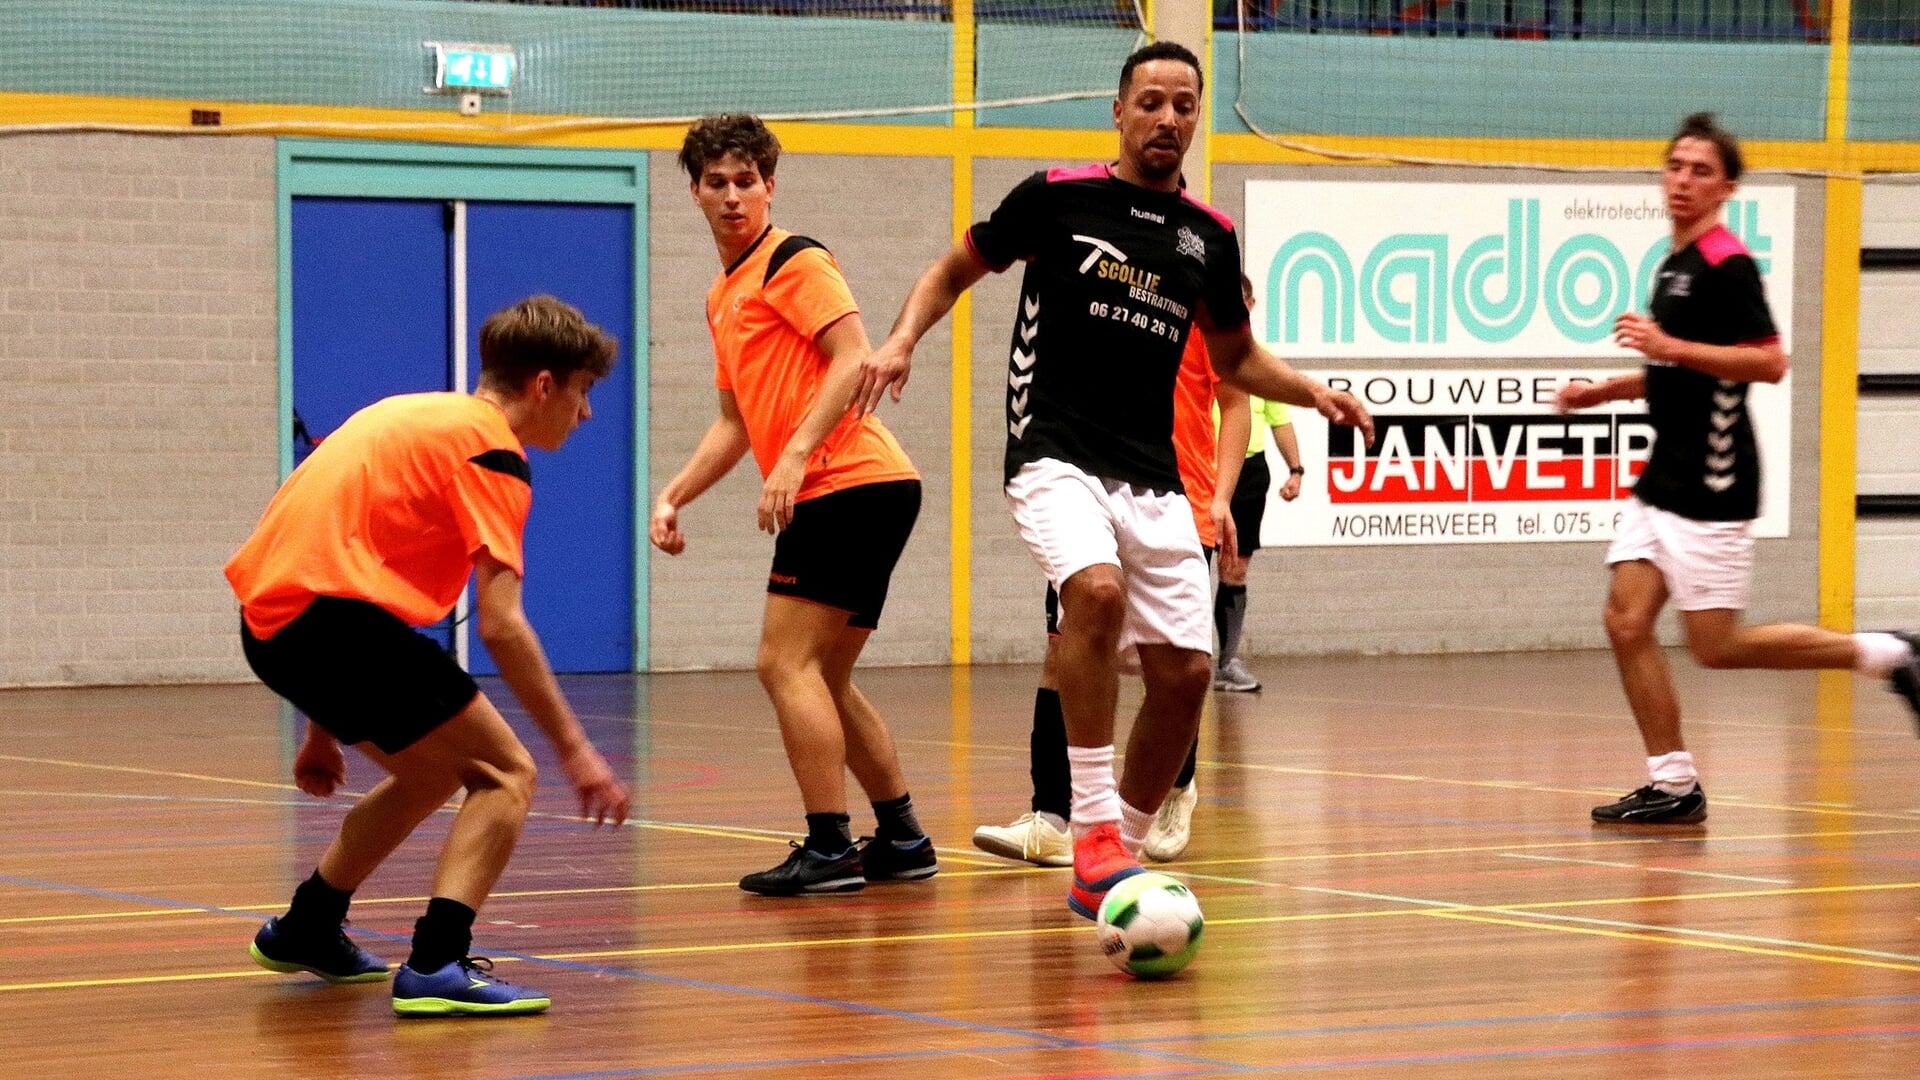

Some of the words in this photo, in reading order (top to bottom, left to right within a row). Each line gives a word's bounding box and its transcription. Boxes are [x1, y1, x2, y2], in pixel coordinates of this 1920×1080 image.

[1130, 206, 1165, 224] hummel
[1097, 259, 1161, 293] SCOLLIE
[1129, 285, 1188, 320] BESTRATINGEN
[1089, 301, 1109, 317] 06
[1111, 306, 1129, 322] 27
[1131, 312, 1149, 329] 40
[1150, 318, 1167, 336] 26
[1168, 325, 1180, 343] 78
[1517, 514, 1546, 535] tel.
[1553, 512, 1591, 533] 075
